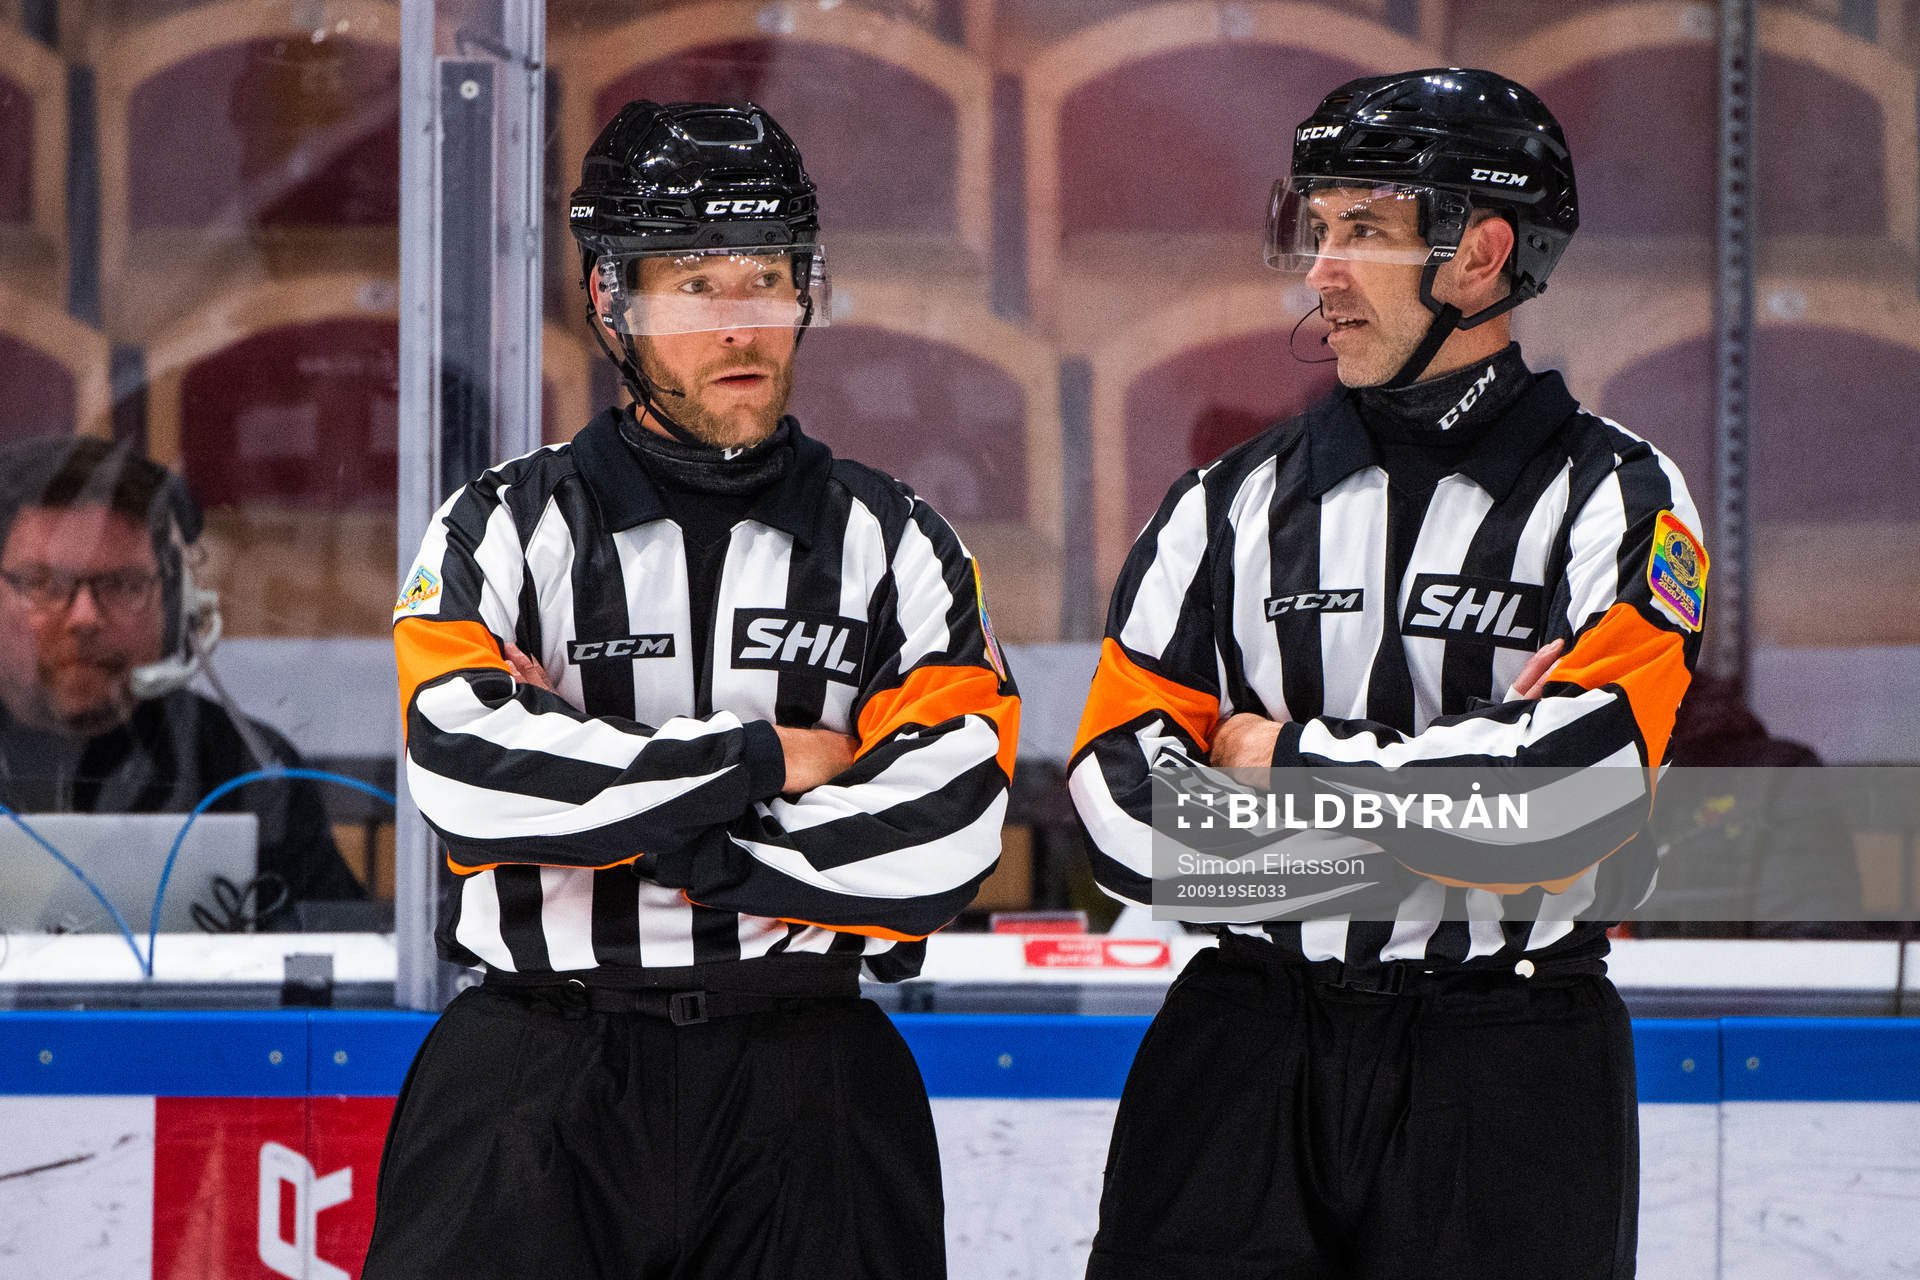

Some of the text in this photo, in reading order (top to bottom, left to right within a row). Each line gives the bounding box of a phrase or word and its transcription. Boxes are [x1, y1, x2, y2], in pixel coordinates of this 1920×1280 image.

[1300, 125, 1343, 142] CCM
[1471, 168, 1529, 187] CCM
[569, 206, 595, 218] CCM
[705, 199, 780, 215] CCM
[1437, 364, 1496, 431] CCM
[1267, 592, 1360, 617] CCM
[1410, 584, 1534, 640] SHL
[573, 638, 671, 660] CCM
[739, 617, 857, 673] SHL
